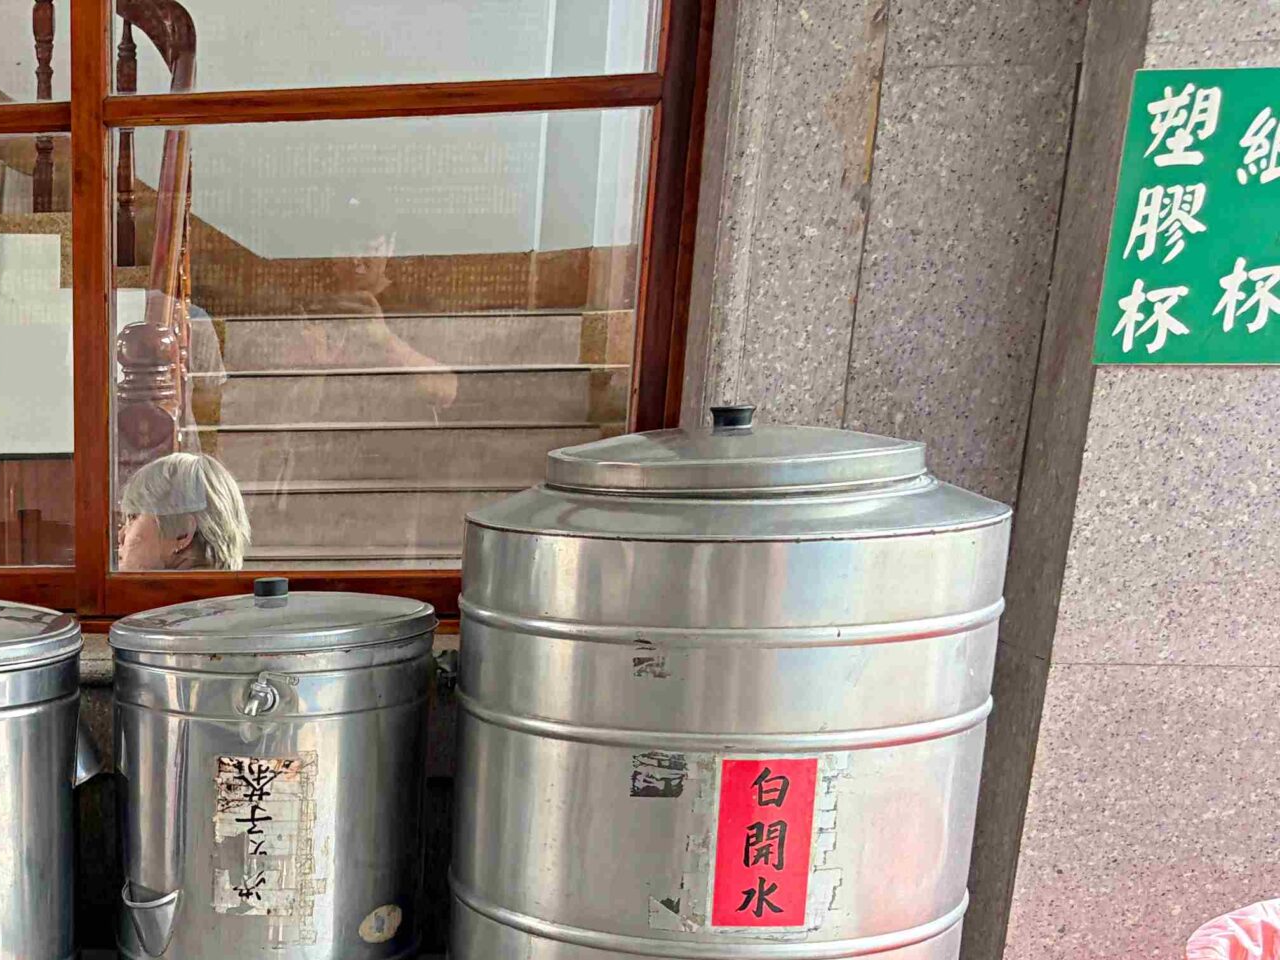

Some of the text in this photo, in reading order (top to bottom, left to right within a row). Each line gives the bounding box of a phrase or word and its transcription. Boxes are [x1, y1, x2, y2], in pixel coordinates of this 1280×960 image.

[1112, 82, 1222, 354] 塑膠杯
[735, 767, 791, 917] 白開水
